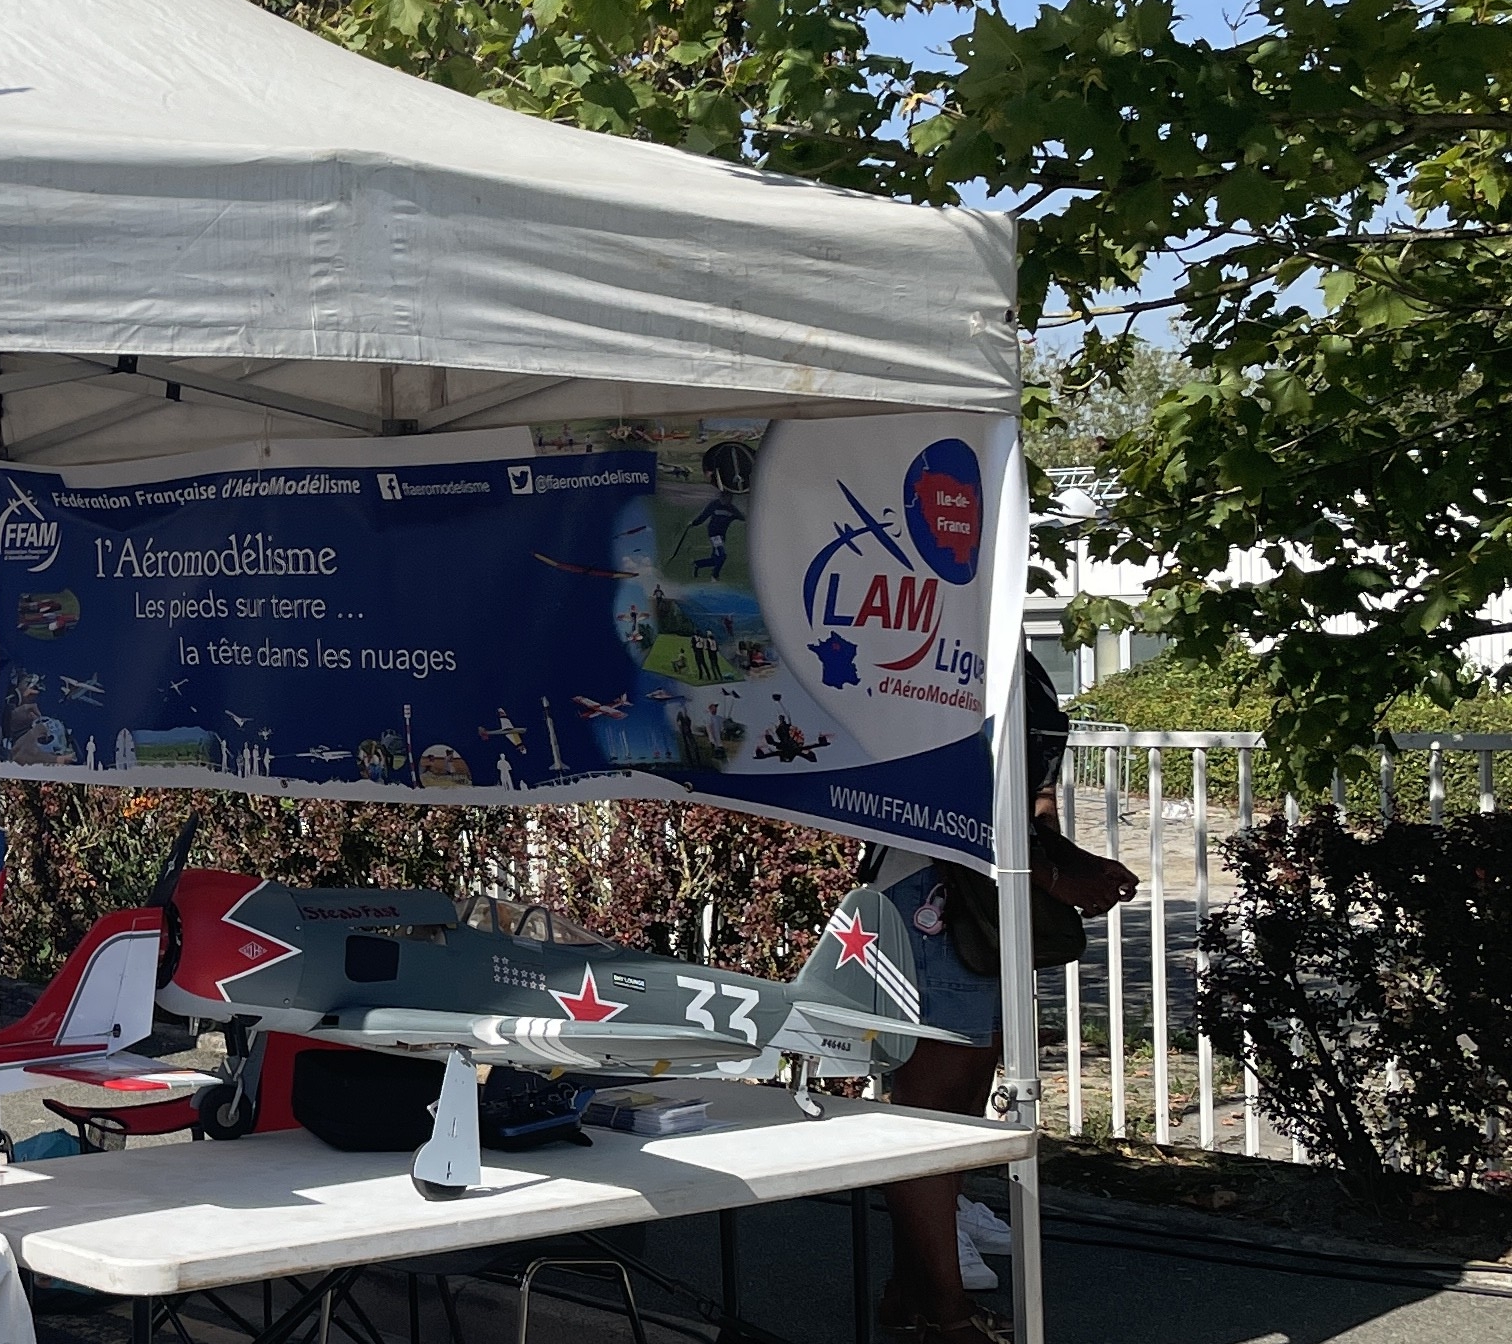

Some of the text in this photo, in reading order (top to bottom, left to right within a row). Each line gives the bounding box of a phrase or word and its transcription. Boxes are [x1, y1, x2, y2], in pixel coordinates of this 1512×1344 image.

[52, 475, 362, 511] Fédération Française d'AéroModélisme
[4, 521, 58, 548] FFAM
[937, 517, 971, 535] France
[95, 533, 338, 579] l'Aéromodélisme
[135, 591, 167, 619] Les
[169, 589, 229, 627] pieds
[236, 596, 267, 619] sur
[272, 594, 327, 619] terre
[823, 573, 939, 634] LAM
[180, 637, 457, 678] la tête dans les nuages
